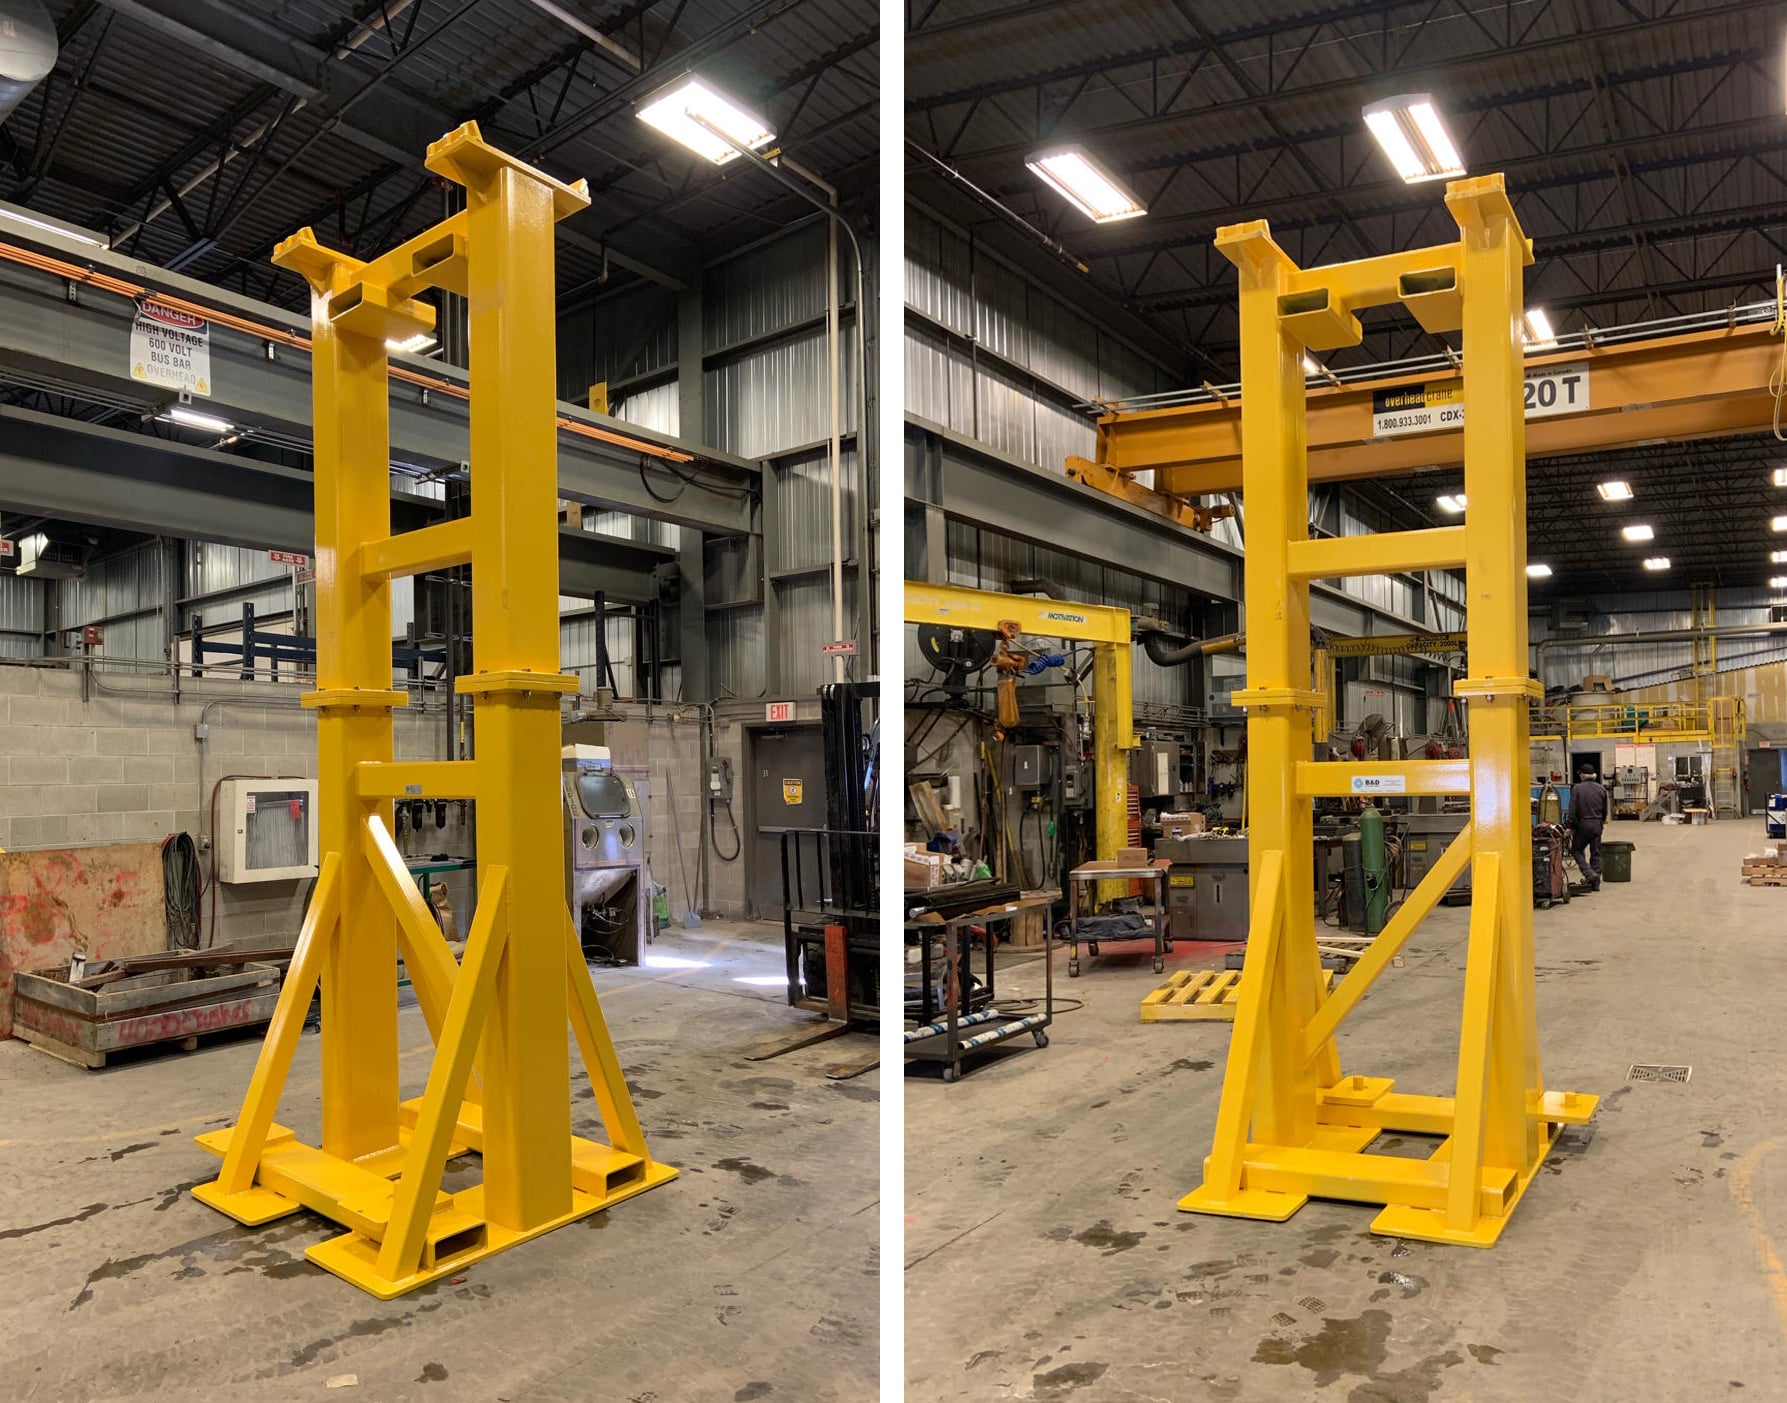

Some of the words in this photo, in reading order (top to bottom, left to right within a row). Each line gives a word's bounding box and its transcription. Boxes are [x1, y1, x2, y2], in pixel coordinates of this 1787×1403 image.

[141, 301, 196, 325] DANGER
[135, 321, 159, 336] HIGH
[161, 327, 203, 347] VOLTAGE
[149, 337, 166, 351] 600
[169, 342, 192, 357] VOLT
[151, 351, 170, 365] BUS
[173, 357, 192, 370] BAR
[146, 364, 196, 385] OVERHEAD
[1525, 379, 1556, 409] 20
[1562, 375, 1581, 404] T
[1377, 413, 1432, 430] 1.800.933.3001
[1047, 612, 1084, 623] MOTIVATION
[770, 703, 789, 720] EXIT
